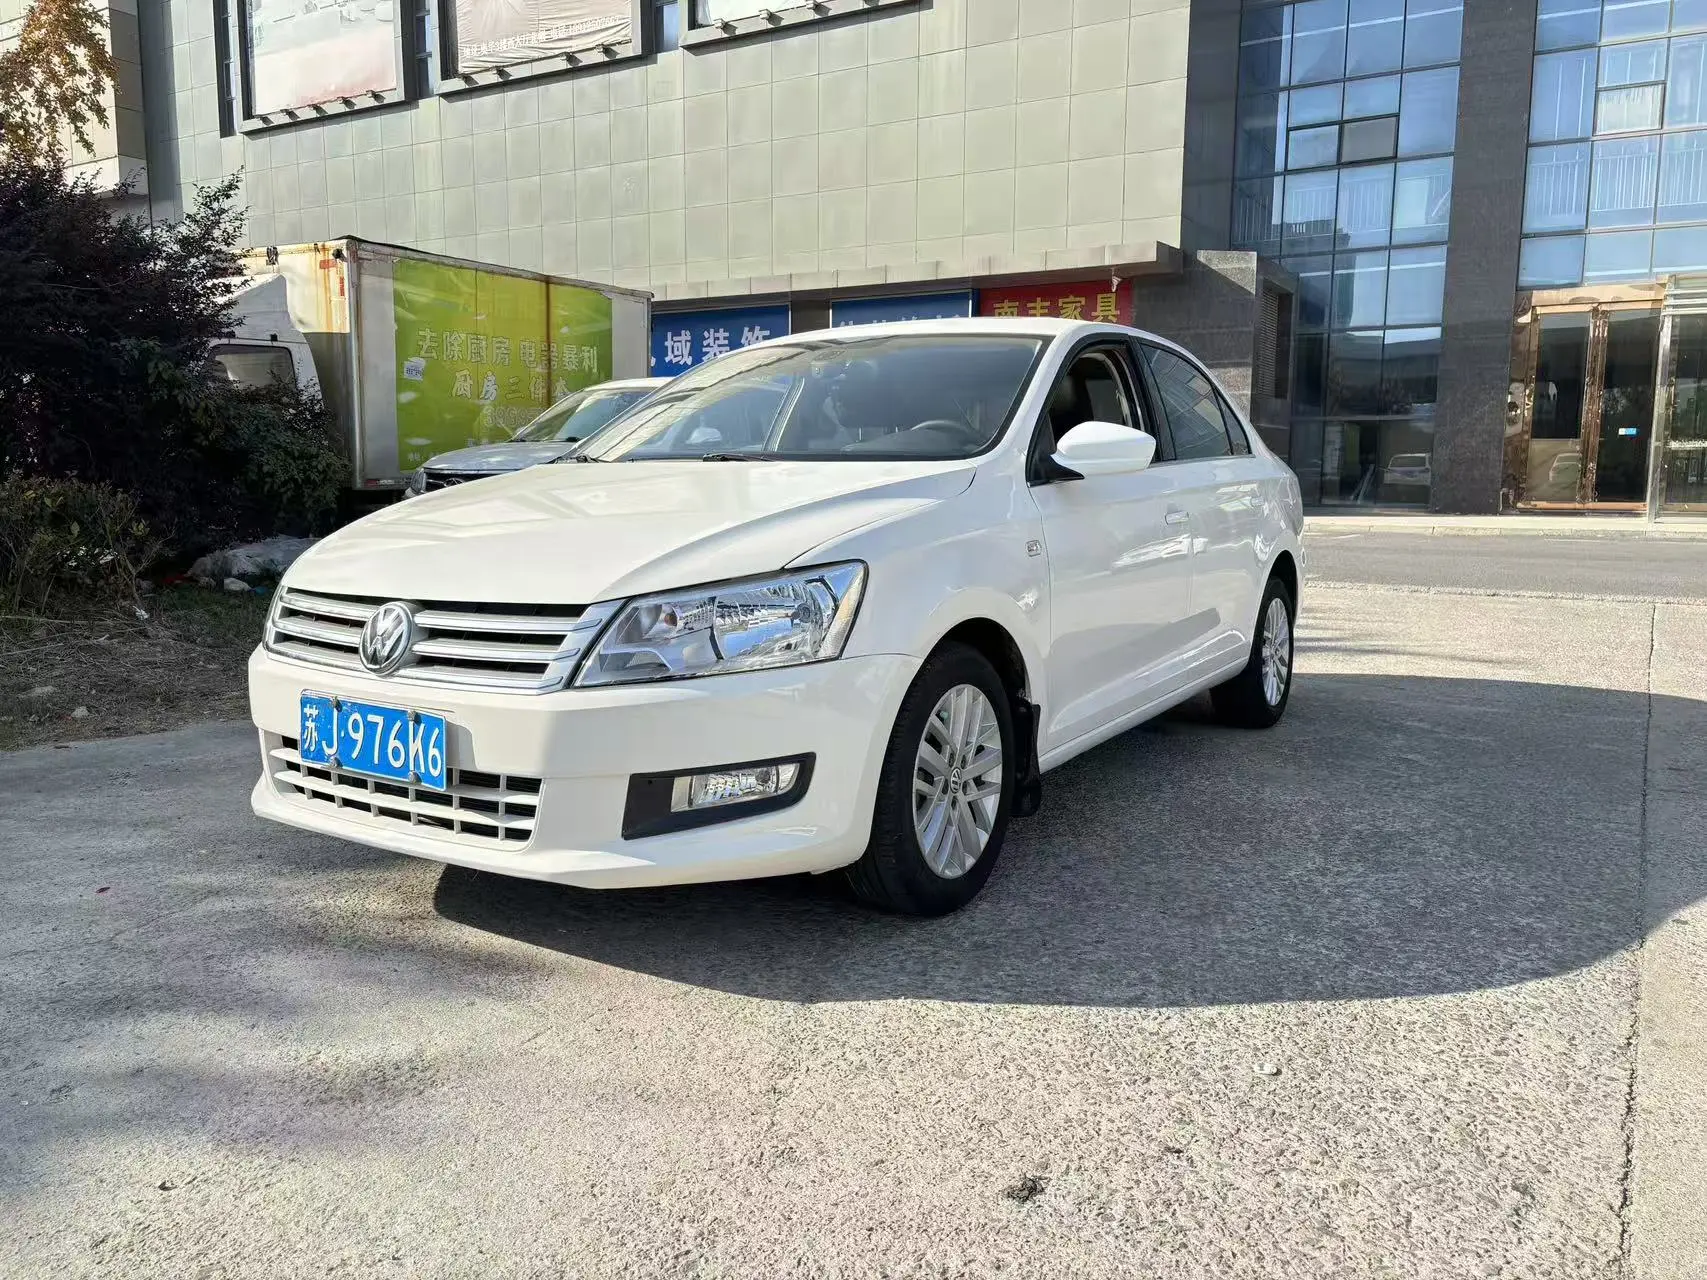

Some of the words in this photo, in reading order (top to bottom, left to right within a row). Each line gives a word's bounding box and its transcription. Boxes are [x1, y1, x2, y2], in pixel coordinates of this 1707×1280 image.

[993, 292, 1120, 322] 南丰家具
[651, 325, 770, 367] 域装饰
